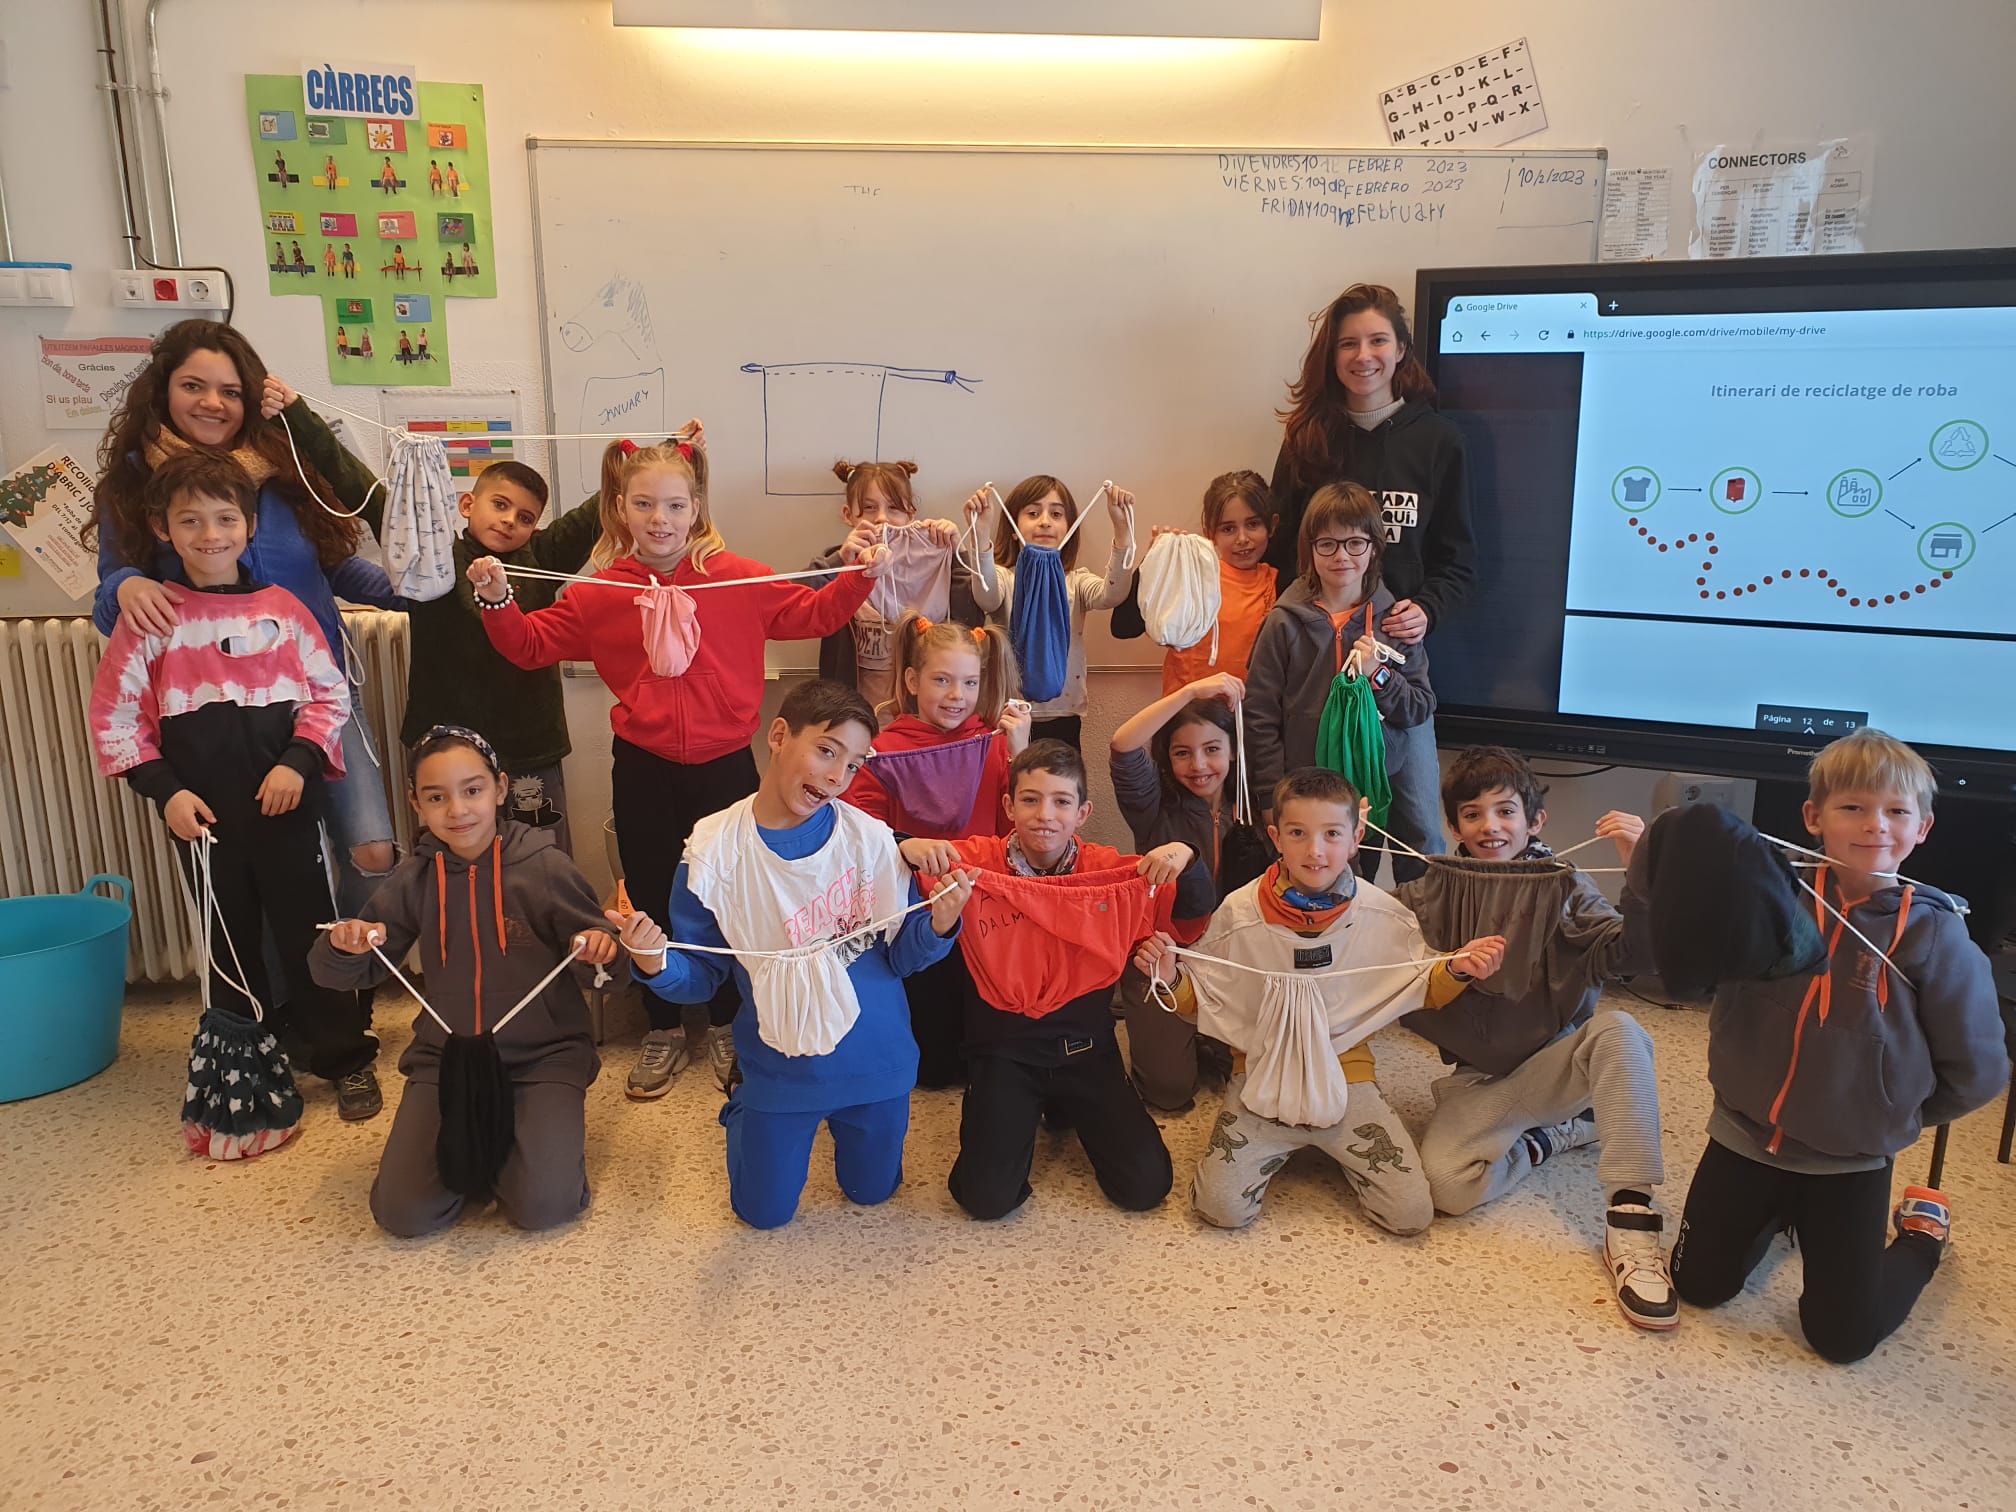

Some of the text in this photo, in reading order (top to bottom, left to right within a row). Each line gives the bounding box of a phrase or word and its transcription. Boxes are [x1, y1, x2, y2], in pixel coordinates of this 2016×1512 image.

[307, 64, 414, 116] CÀRRECS
[1348, 157, 1404, 174] FEBRER
[1427, 158, 1467, 174] 2023
[1708, 152, 1807, 170] CONNECTORS
[1518, 167, 1585, 188] 10/2/2023
[1344, 182, 1410, 200] FEBRERO
[1422, 178, 1464, 194] 2023
[1466, 302, 1518, 313] Google Drive
[1583, 325, 1827, 340] https://drive.google.com/drive/mobile/my-drive
[78, 363, 116, 372] Gràcies
[46, 395, 93, 406] Si us plau
[1711, 383, 1958, 401] Itinerari de reciclatge de roba
[1763, 714, 1856, 729] Página 12 de 13
[979, 911, 1025, 939] DALM
